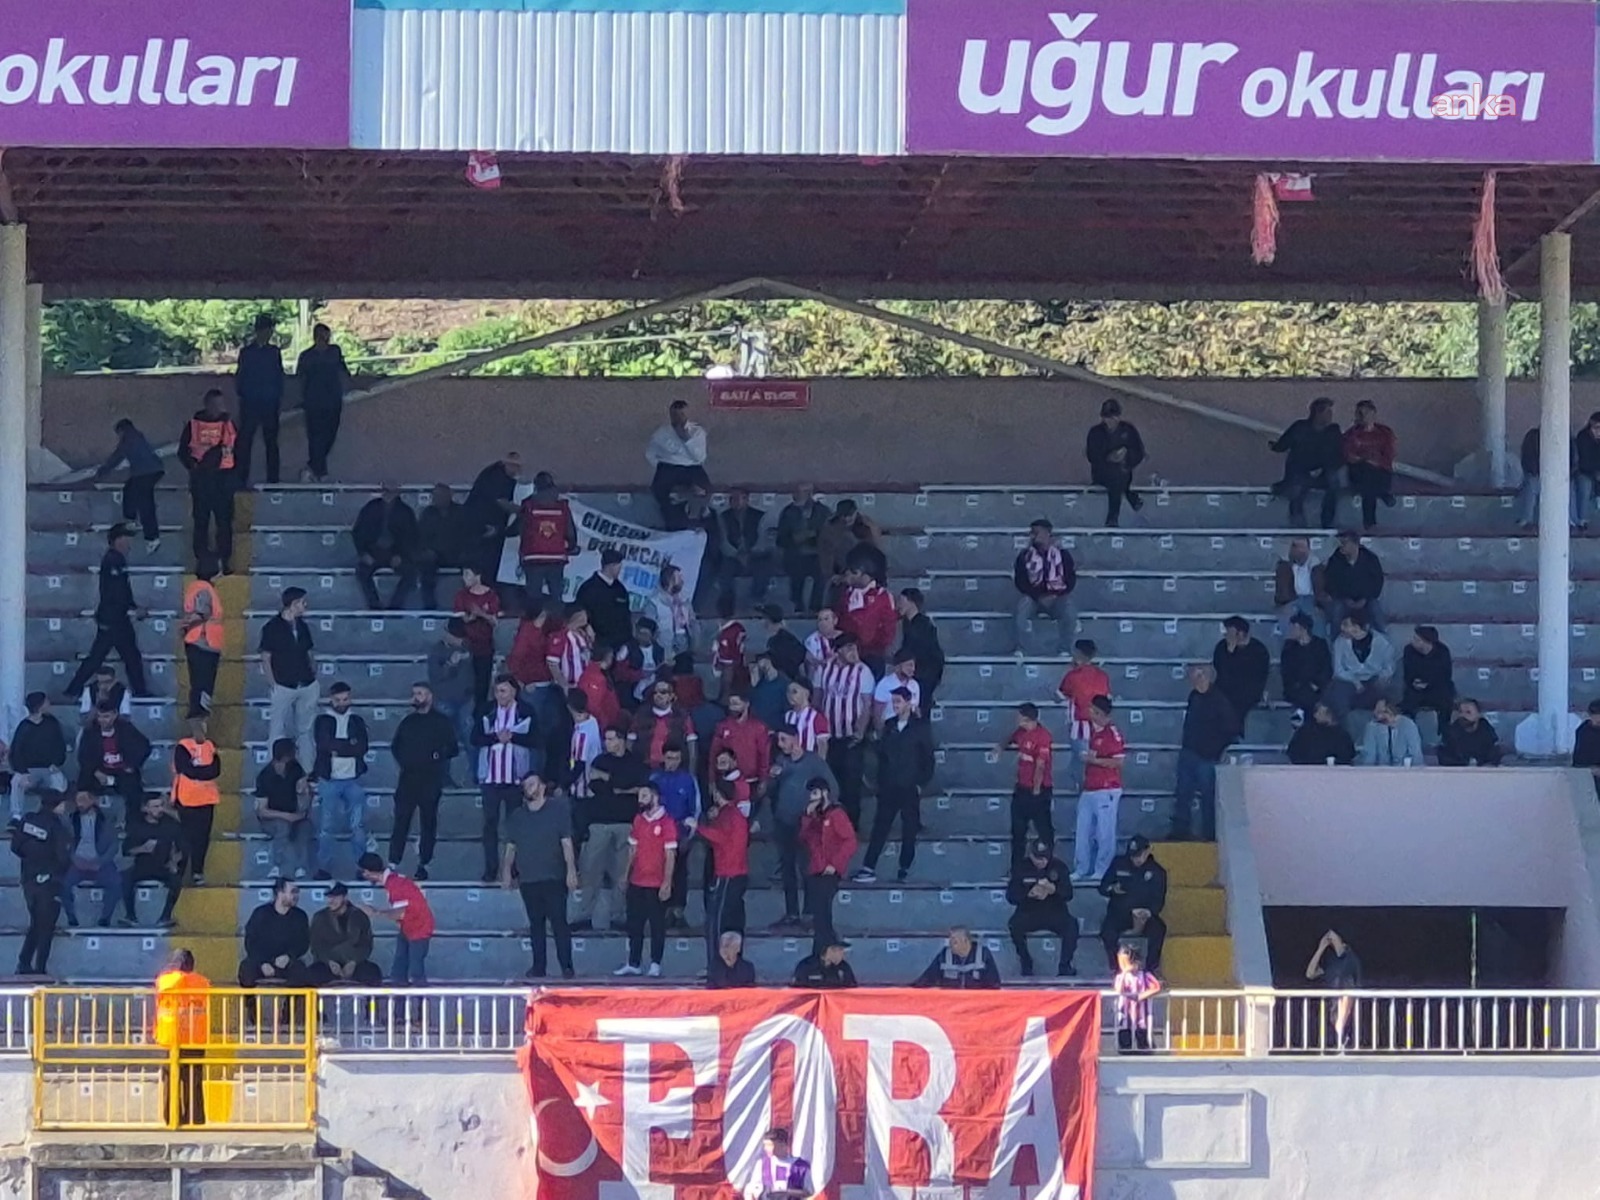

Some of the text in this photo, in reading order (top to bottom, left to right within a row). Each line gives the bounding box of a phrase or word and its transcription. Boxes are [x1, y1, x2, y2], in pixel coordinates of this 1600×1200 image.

[0, 38, 297, 105] okulları
[959, 13, 1544, 135] uğur okulları
[596, 1013, 1080, 1200] FORA
